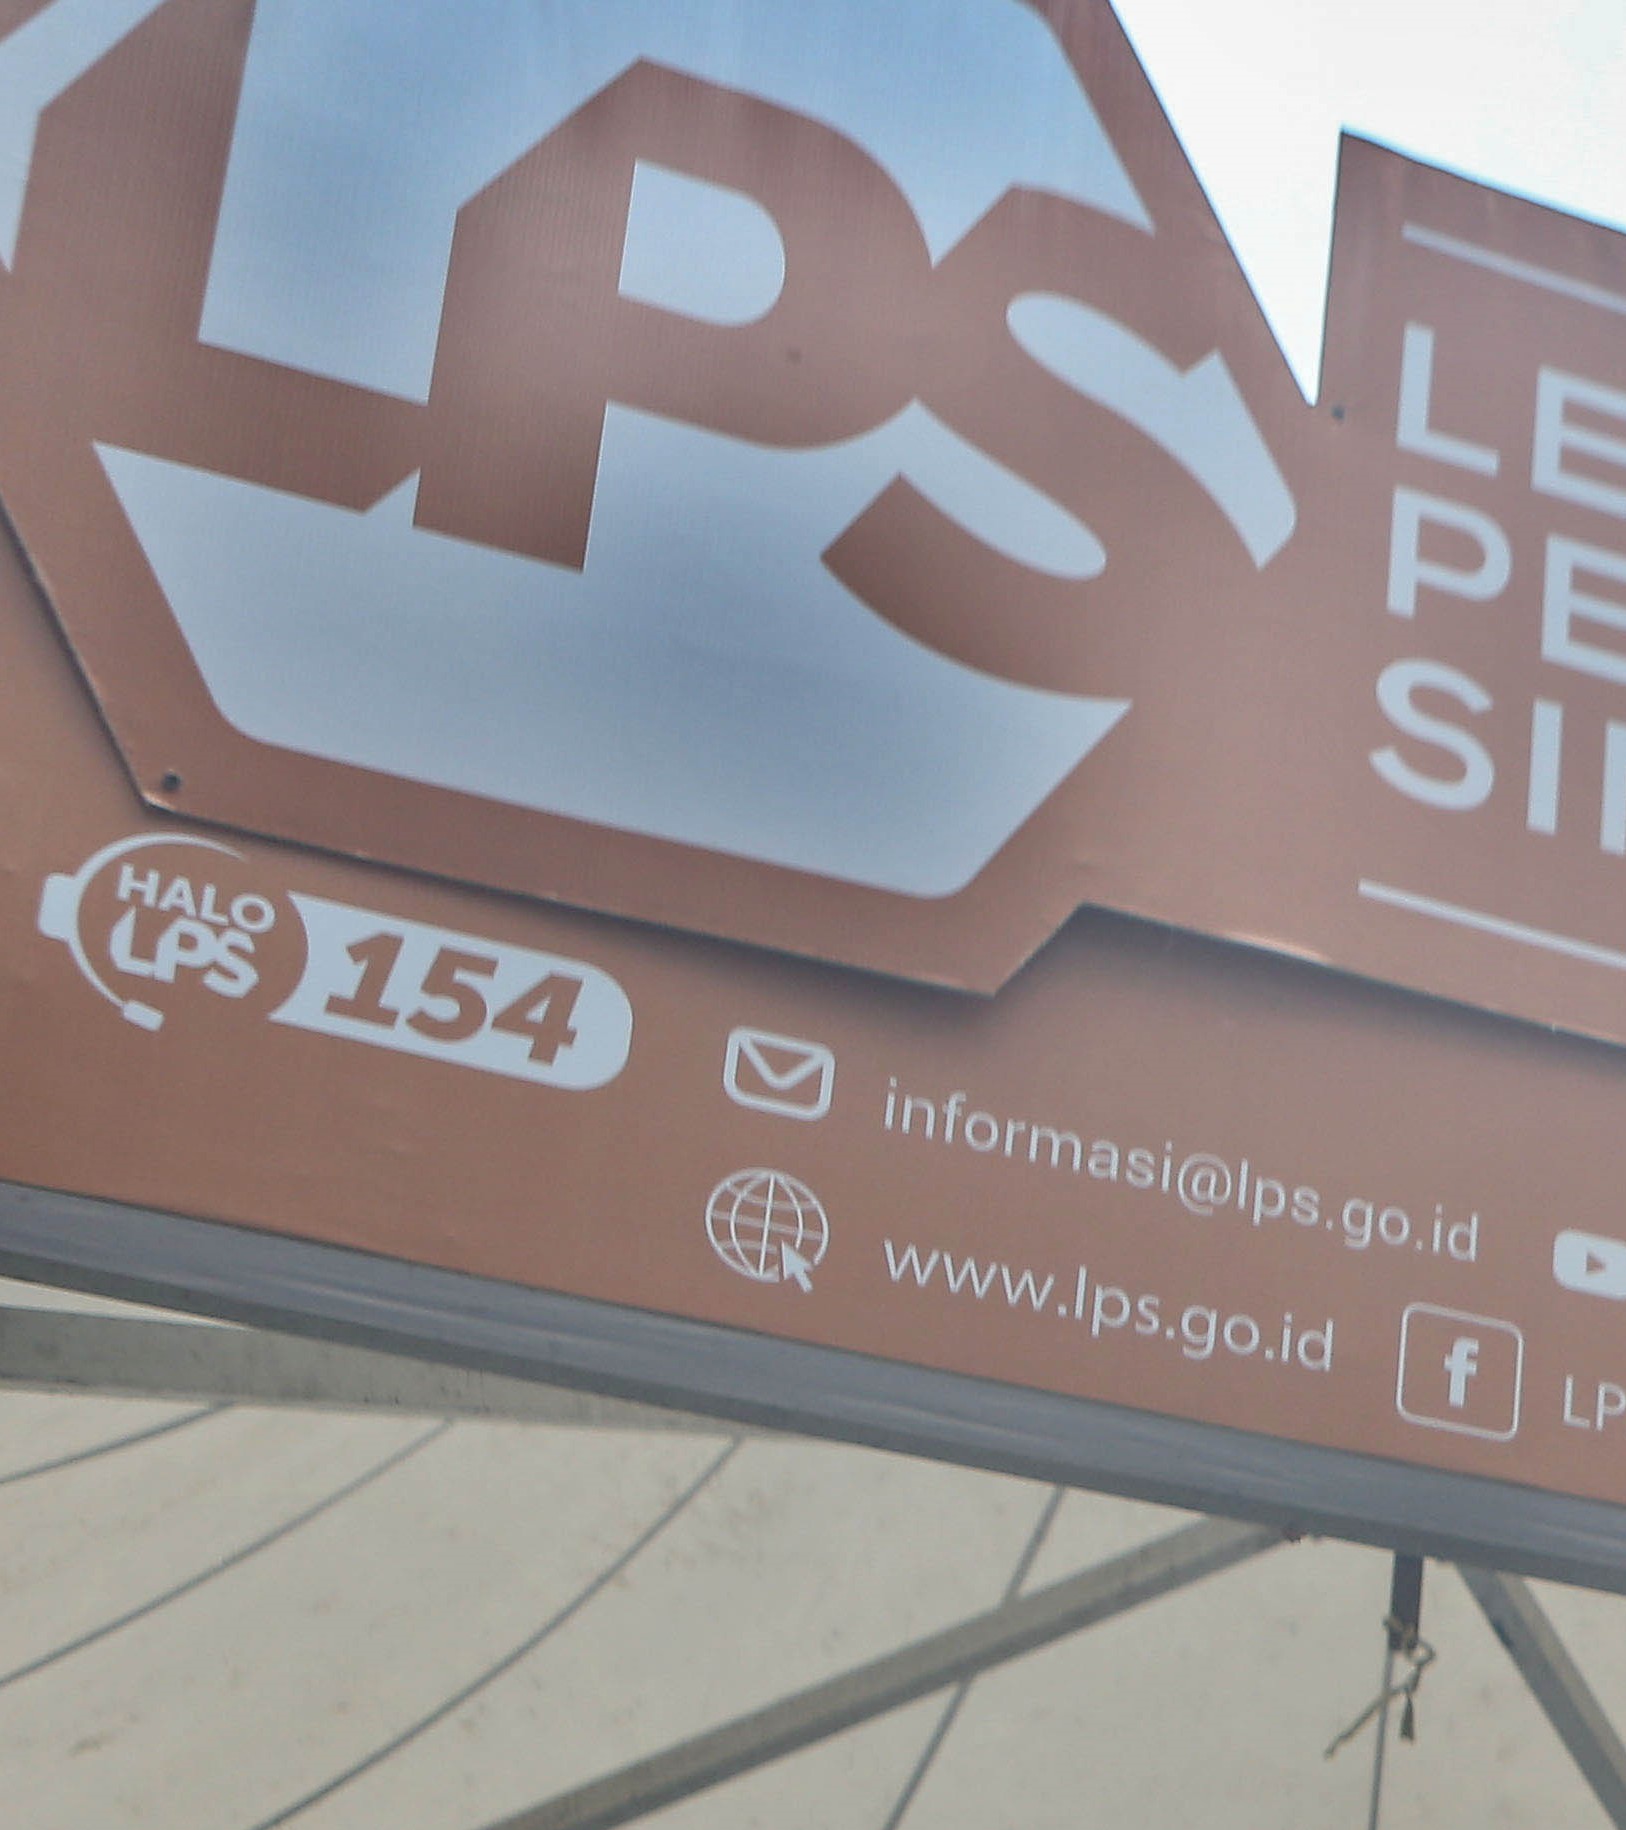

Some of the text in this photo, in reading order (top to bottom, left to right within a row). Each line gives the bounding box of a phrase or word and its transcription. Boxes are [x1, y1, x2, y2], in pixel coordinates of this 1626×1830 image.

[109, 906, 260, 999] LPS
[116, 863, 275, 934] HALO
[324, 930, 585, 1067] 154
[882, 1077, 1481, 1264] informasi@lps.go.id
[883, 1238, 1336, 1373] www.lps.go.id
